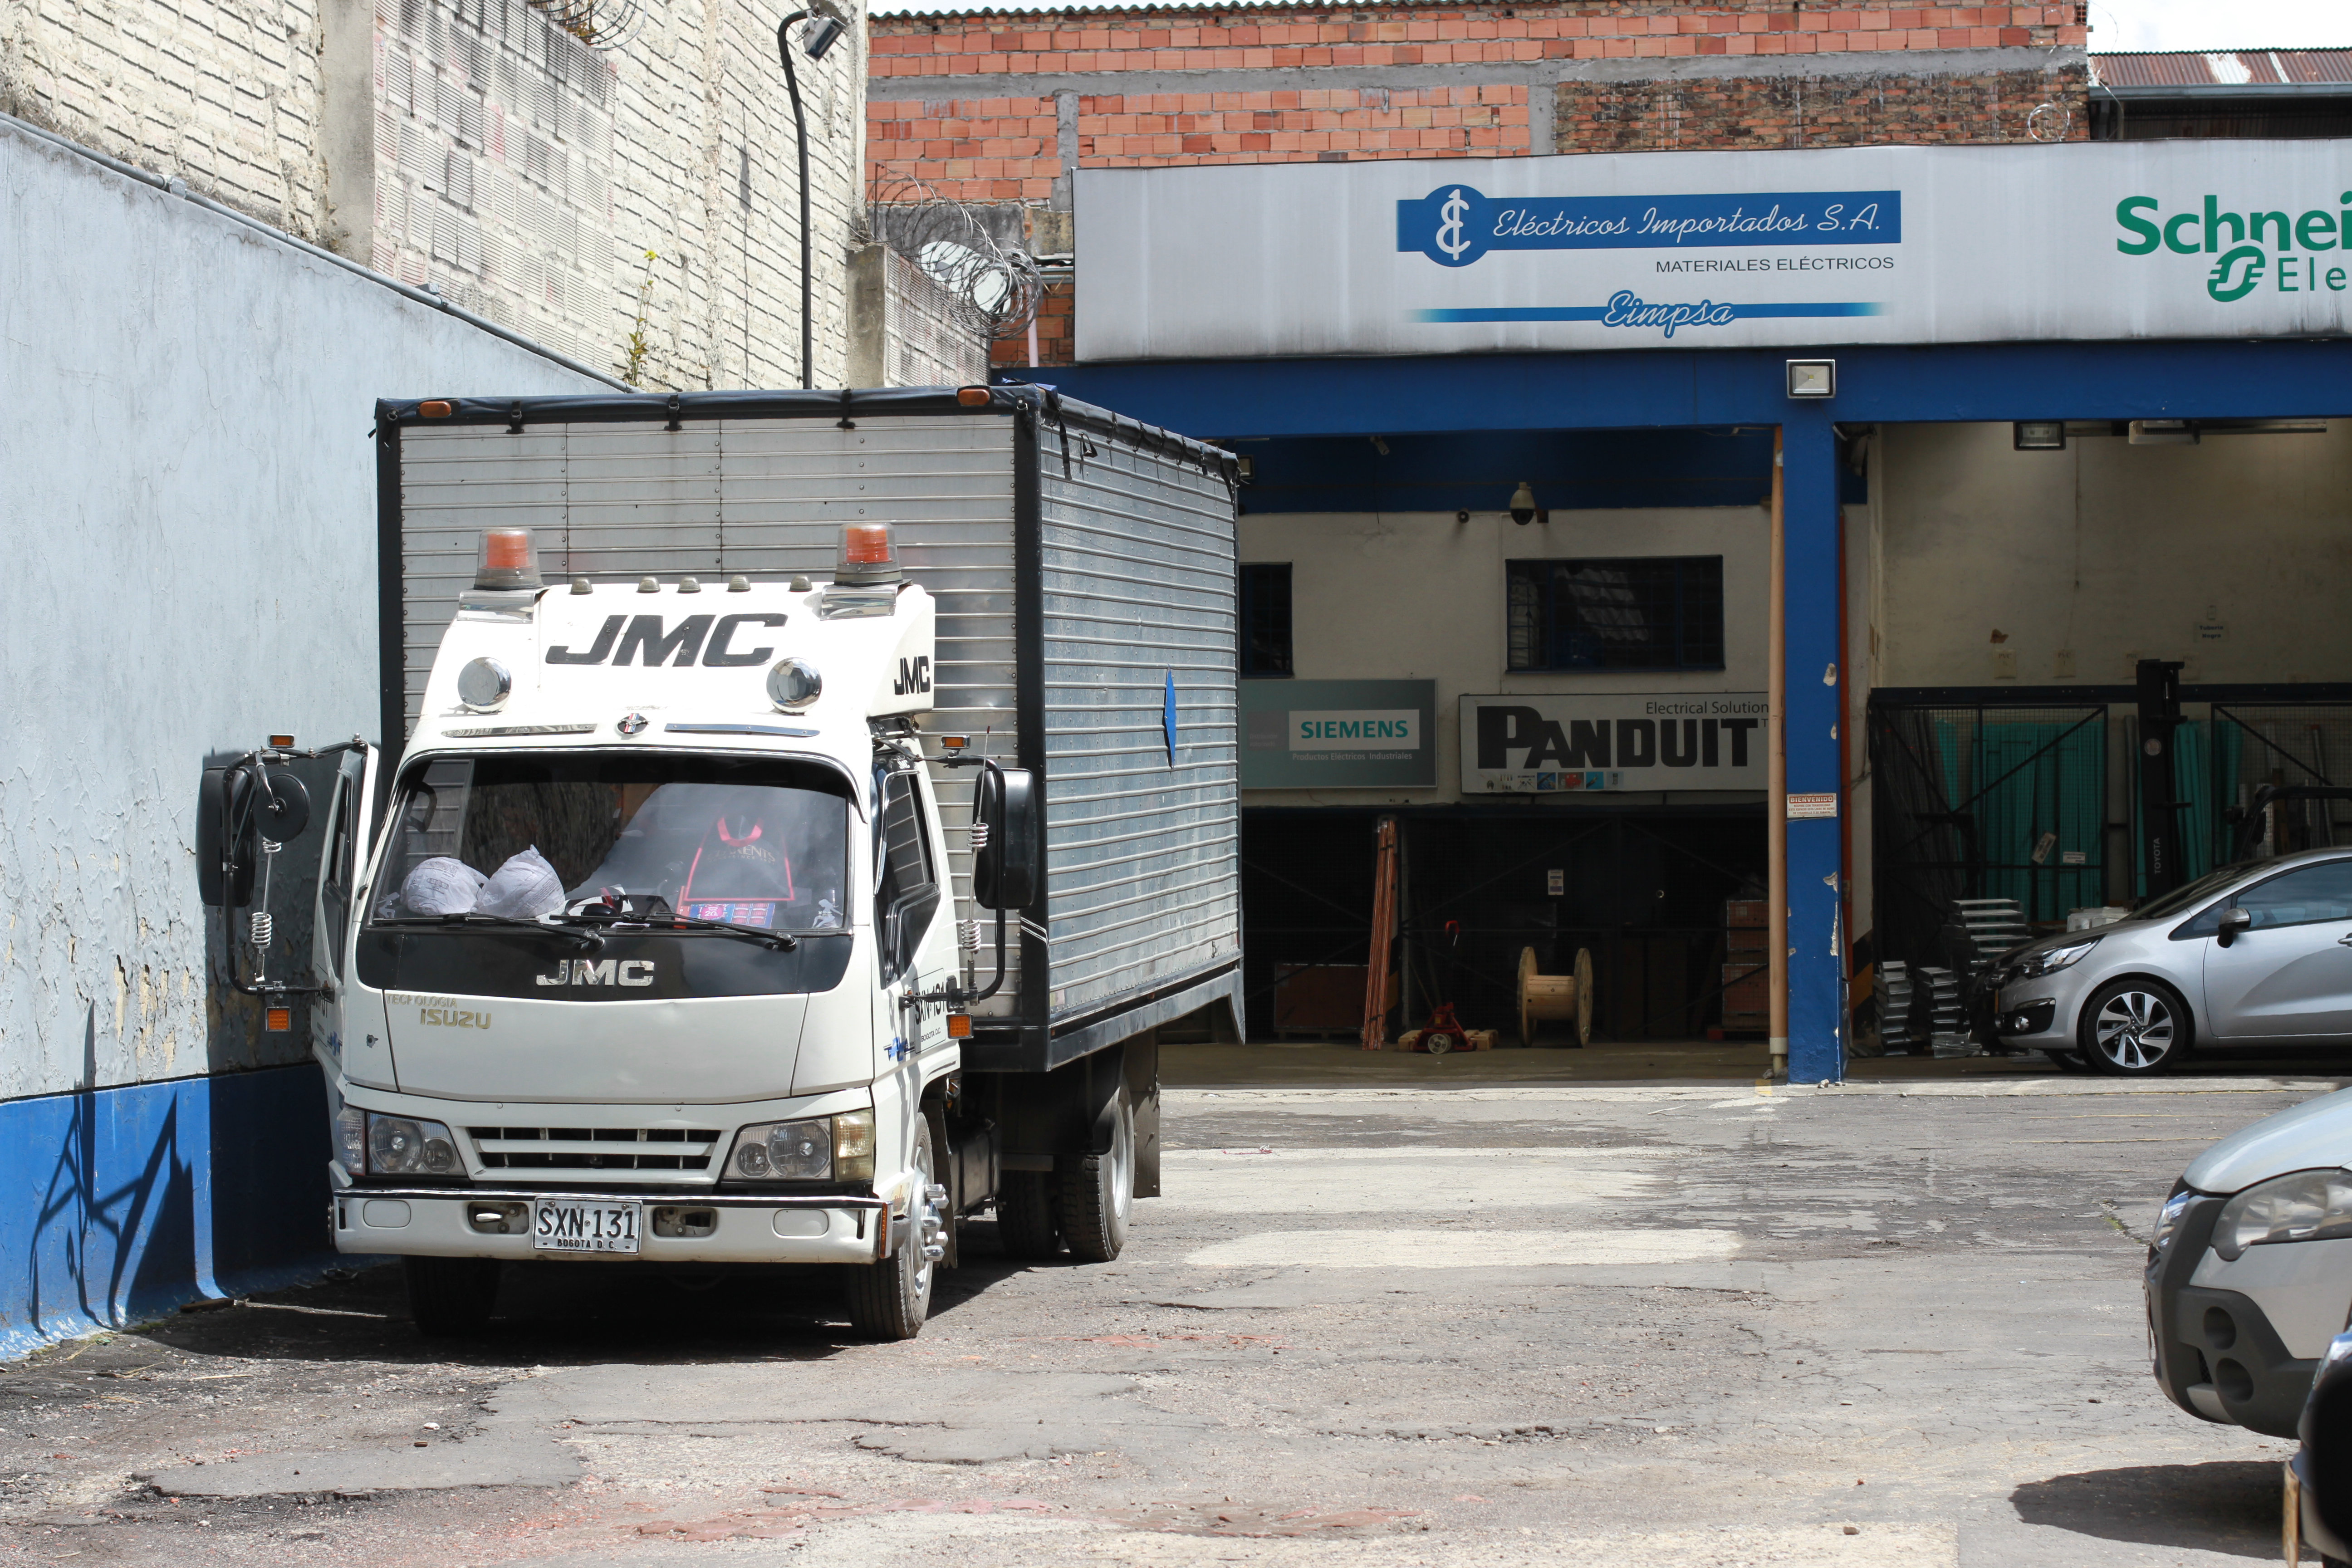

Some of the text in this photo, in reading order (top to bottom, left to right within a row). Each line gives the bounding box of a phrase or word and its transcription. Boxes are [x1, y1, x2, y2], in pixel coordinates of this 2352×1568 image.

[1493, 203, 1880, 243] Eléctricos Importados S.A.
[2116, 191, 2352, 255] Schnei
[1656, 256, 1894, 273] MATERIALES ELÉCTRICOS
[2278, 256, 2347, 292] Ele
[1603, 292, 1733, 337] Eimpsa
[545, 612, 789, 667] JMC
[894, 656, 931, 695] JMC
[1646, 701, 1707, 714] Electrical
[1301, 720, 1408, 739] SIEMENS
[1477, 706, 1758, 769] PANDUIT
[1369, 752, 1412, 760] Industriales
[536, 959, 654, 986] JMC
[420, 1008, 491, 1029] ISUZU
[921, 1030, 935, 1042] BOGOTA
[558, 1238, 592, 1248] BOGOTA
